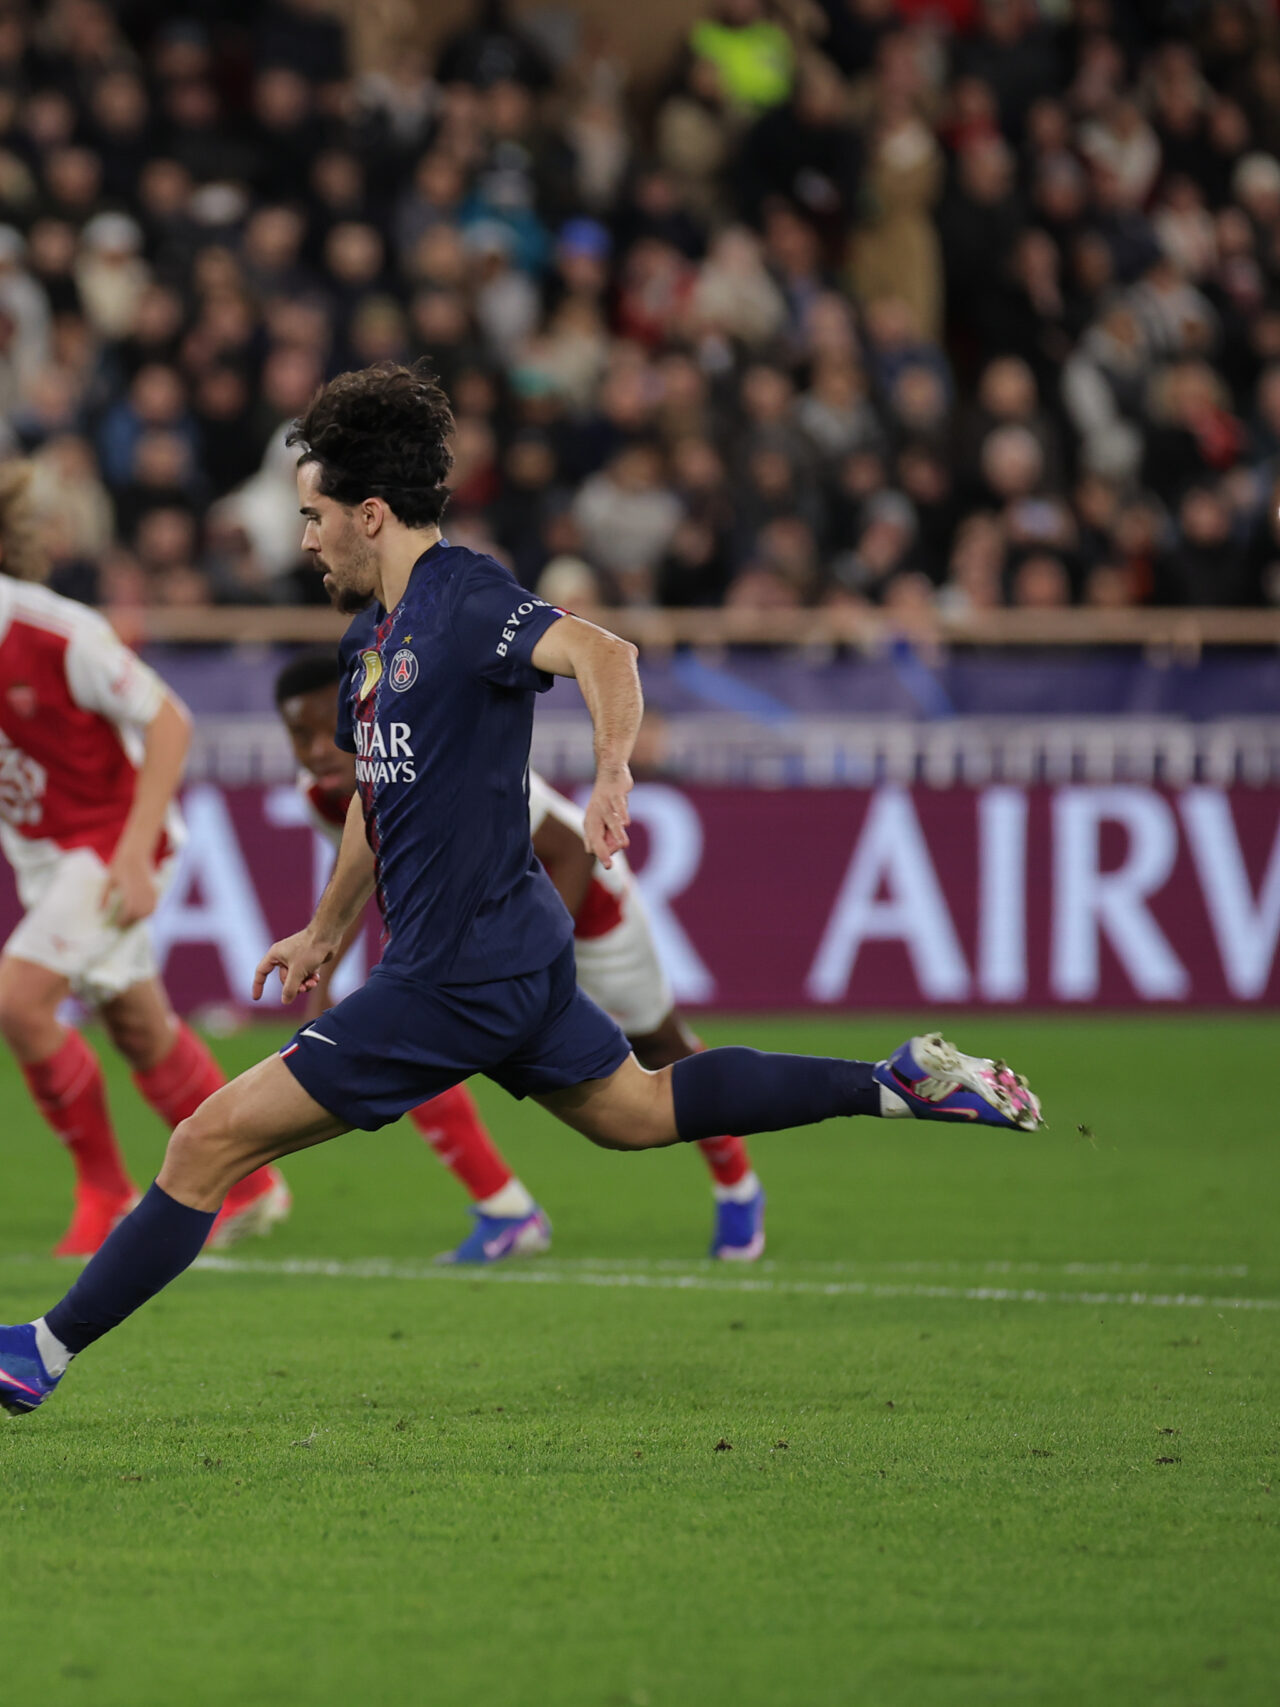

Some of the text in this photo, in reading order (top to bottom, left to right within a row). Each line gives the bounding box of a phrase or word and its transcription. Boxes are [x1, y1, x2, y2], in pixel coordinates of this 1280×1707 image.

[496, 600, 552, 657] BEYO
[353, 720, 414, 758] ATAR
[355, 759, 416, 783] WAYS
